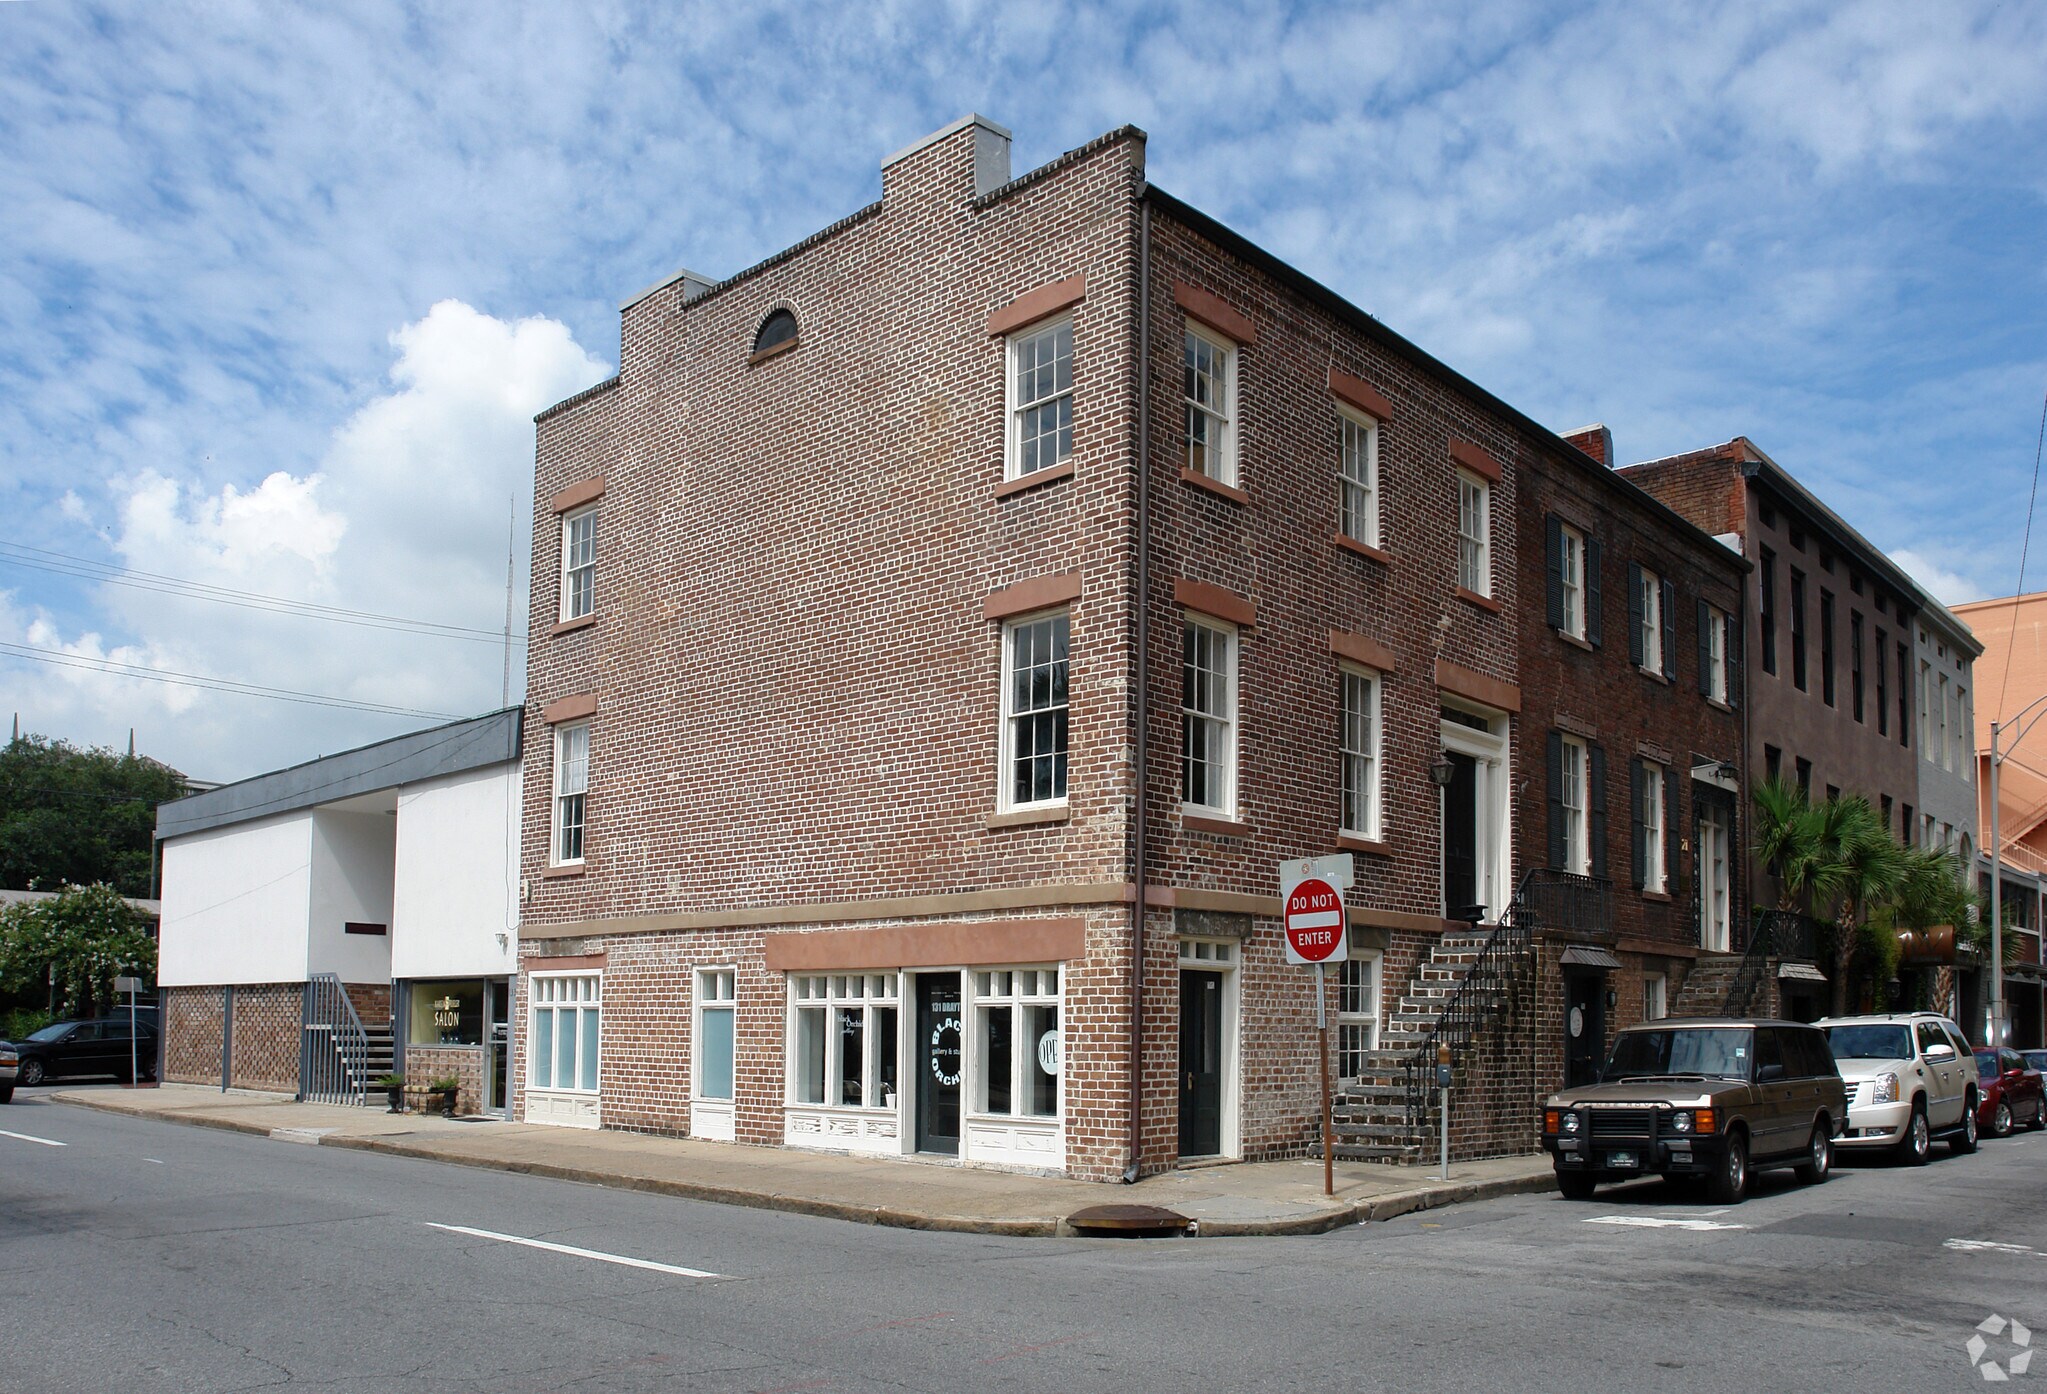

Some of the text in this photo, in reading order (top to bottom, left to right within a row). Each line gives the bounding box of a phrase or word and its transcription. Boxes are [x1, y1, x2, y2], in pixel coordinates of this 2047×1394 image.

[1292, 893, 1334, 910] DO NOT
[1298, 931, 1332, 946] ENTER
[931, 1001, 961, 1012] 131 DRAYT
[434, 1011, 460, 1027] SALON
[932, 1017, 961, 1045] BLAC
[1039, 1038, 1058, 1064] OPE
[932, 1057, 961, 1086] ORCH
